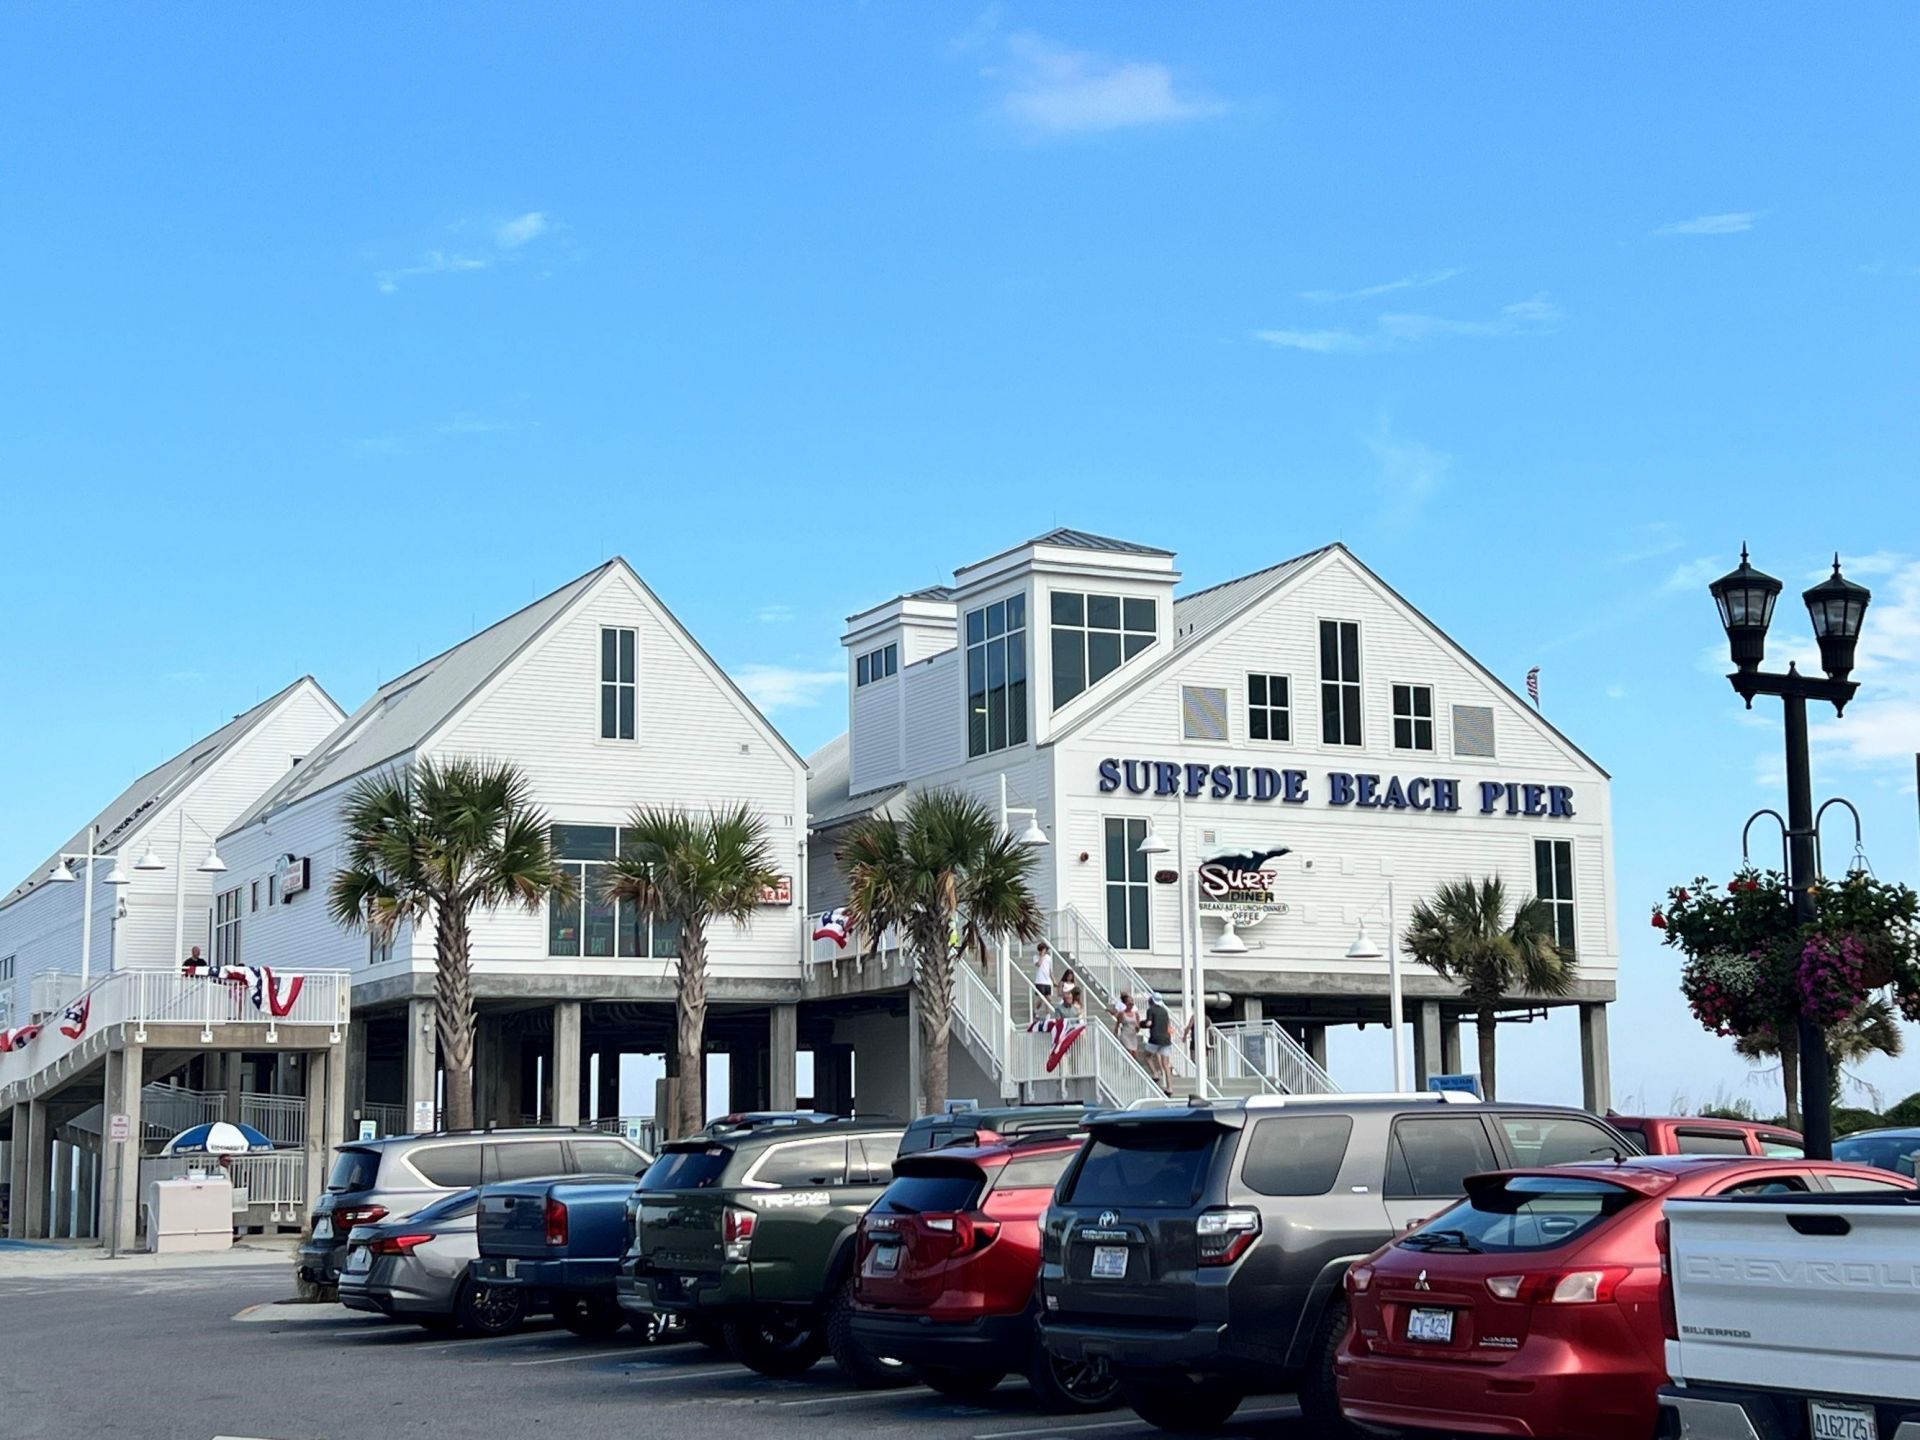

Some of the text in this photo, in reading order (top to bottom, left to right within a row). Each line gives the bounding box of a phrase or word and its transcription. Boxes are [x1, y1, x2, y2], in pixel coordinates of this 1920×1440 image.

[1099, 758, 1577, 818] SURFSIDE BEACH PIER
[1200, 862, 1278, 896] SURF
[1230, 890, 1274, 903] DINER
[1686, 1255, 1920, 1289] CHEVROL
[1682, 1325, 1751, 1339] SILVERADO
[1816, 1413, 1868, 1440] 4162725
